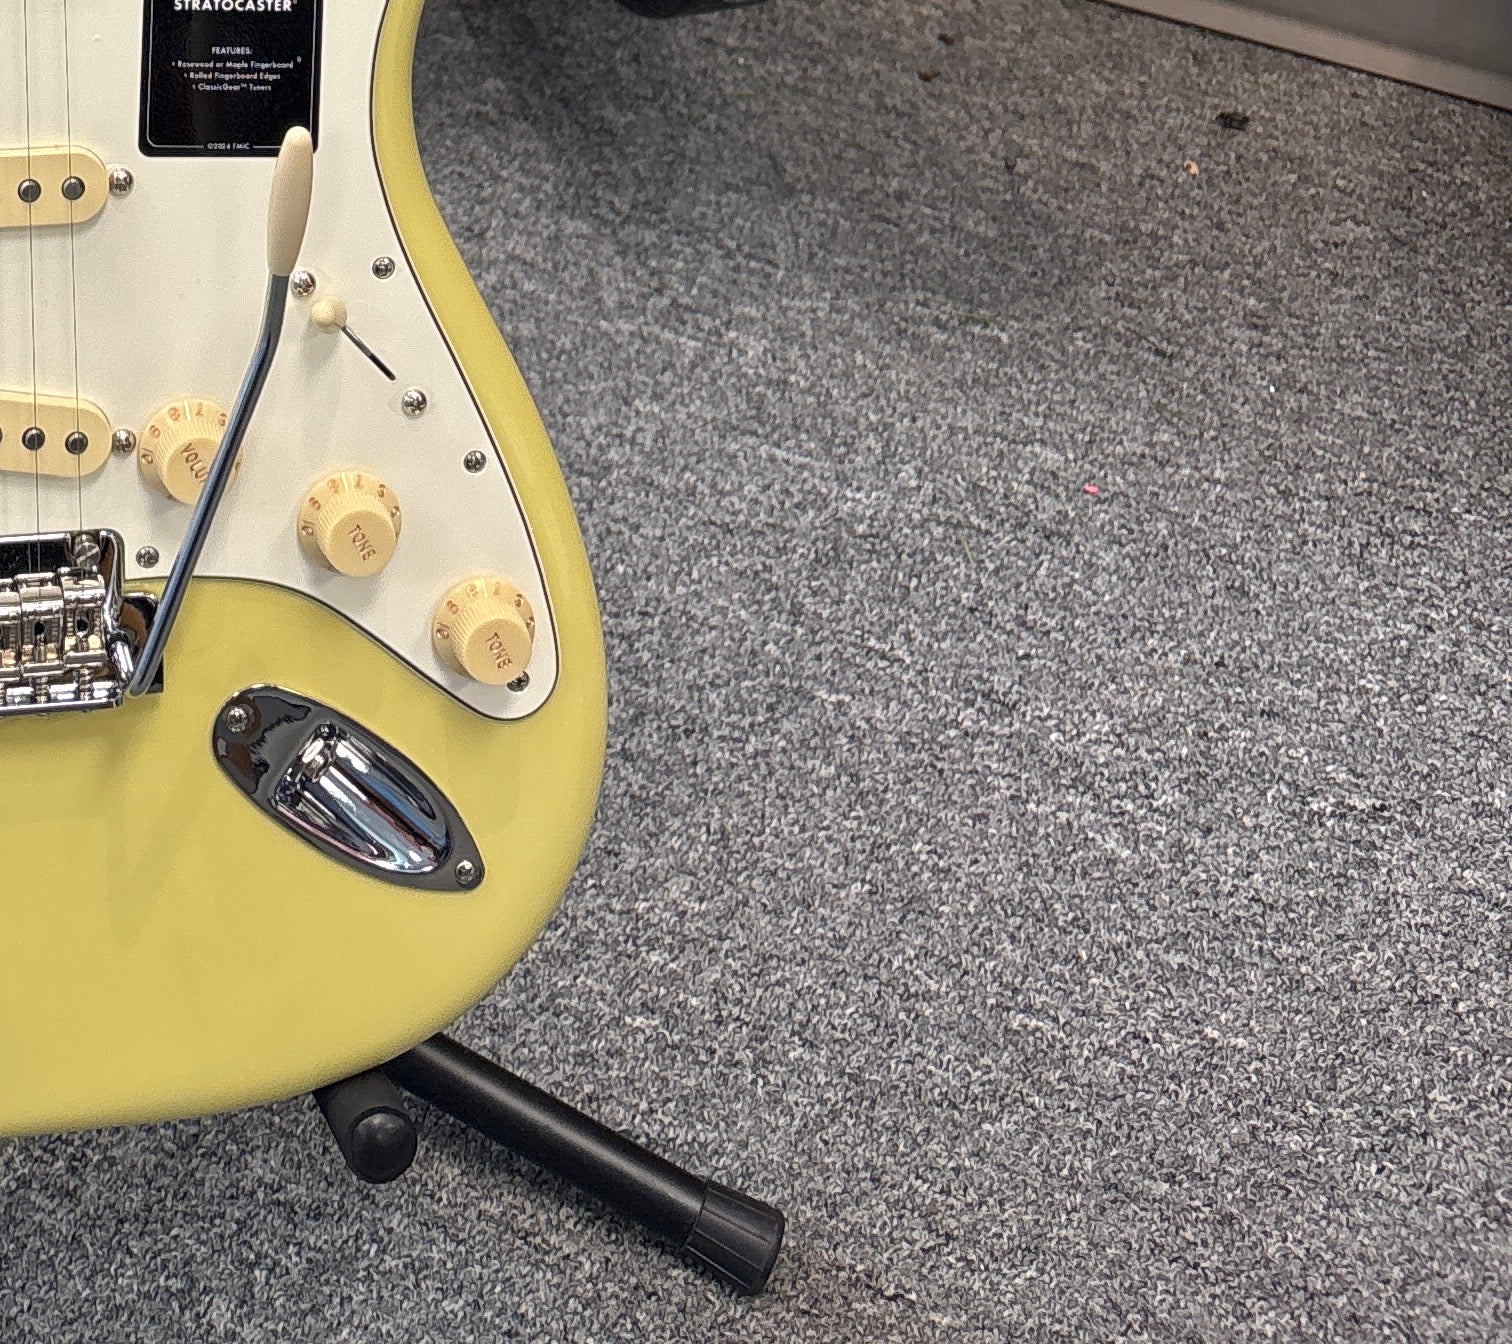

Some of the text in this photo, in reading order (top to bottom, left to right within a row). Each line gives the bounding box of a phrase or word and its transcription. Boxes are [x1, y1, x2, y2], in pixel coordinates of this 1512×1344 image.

[214, 71, 258, 81] Fingerboard
[250, 60, 294, 71] Fingerboard
[181, 442, 208, 483] VOLU
[348, 523, 376, 561] TONE
[486, 632, 513, 671] TONE
